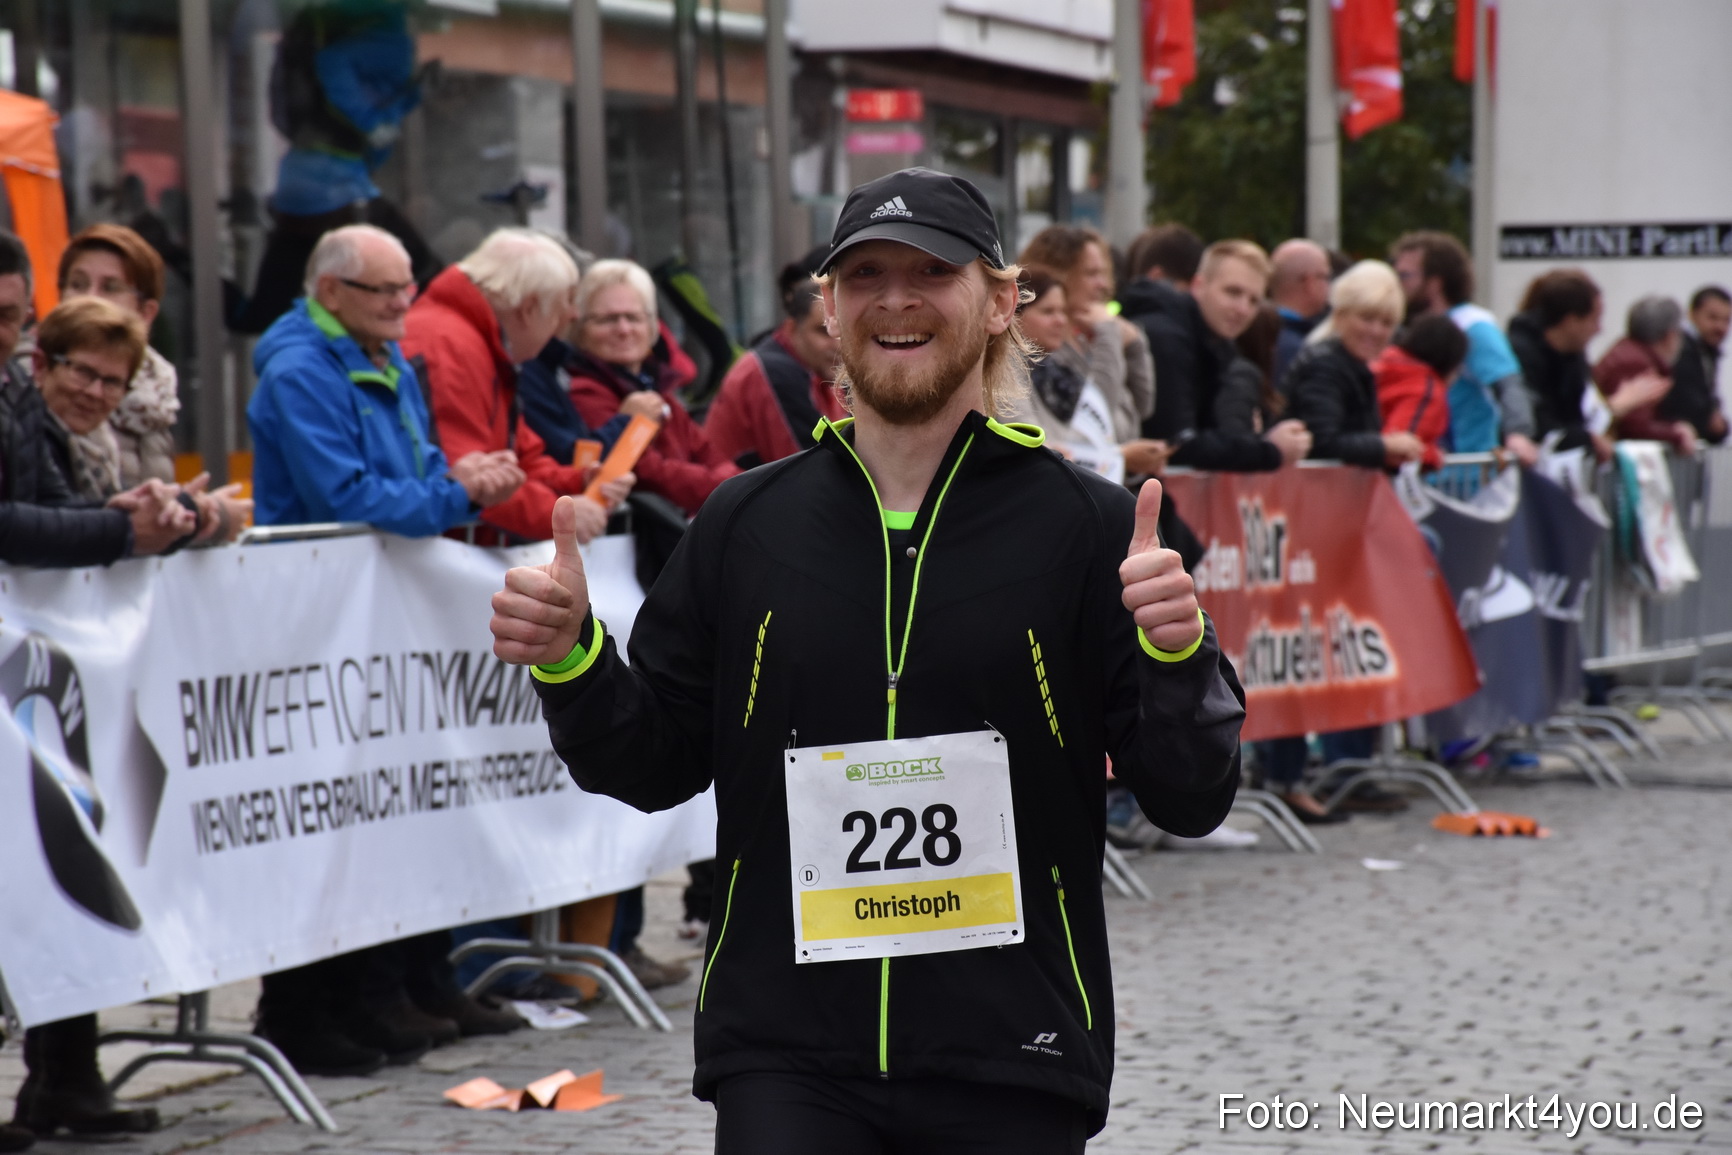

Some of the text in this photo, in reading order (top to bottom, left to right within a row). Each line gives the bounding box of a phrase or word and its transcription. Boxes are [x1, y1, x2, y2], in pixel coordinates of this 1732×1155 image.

[870, 208, 913, 219] adidas
[179, 671, 261, 769] BMW
[867, 757, 944, 780] BOCK
[919, 775, 945, 783] concepts
[842, 803, 962, 874] 228
[804, 869, 814, 882] D
[854, 890, 961, 920] Christoph
[1040, 1047, 1063, 1056] TOUCH
